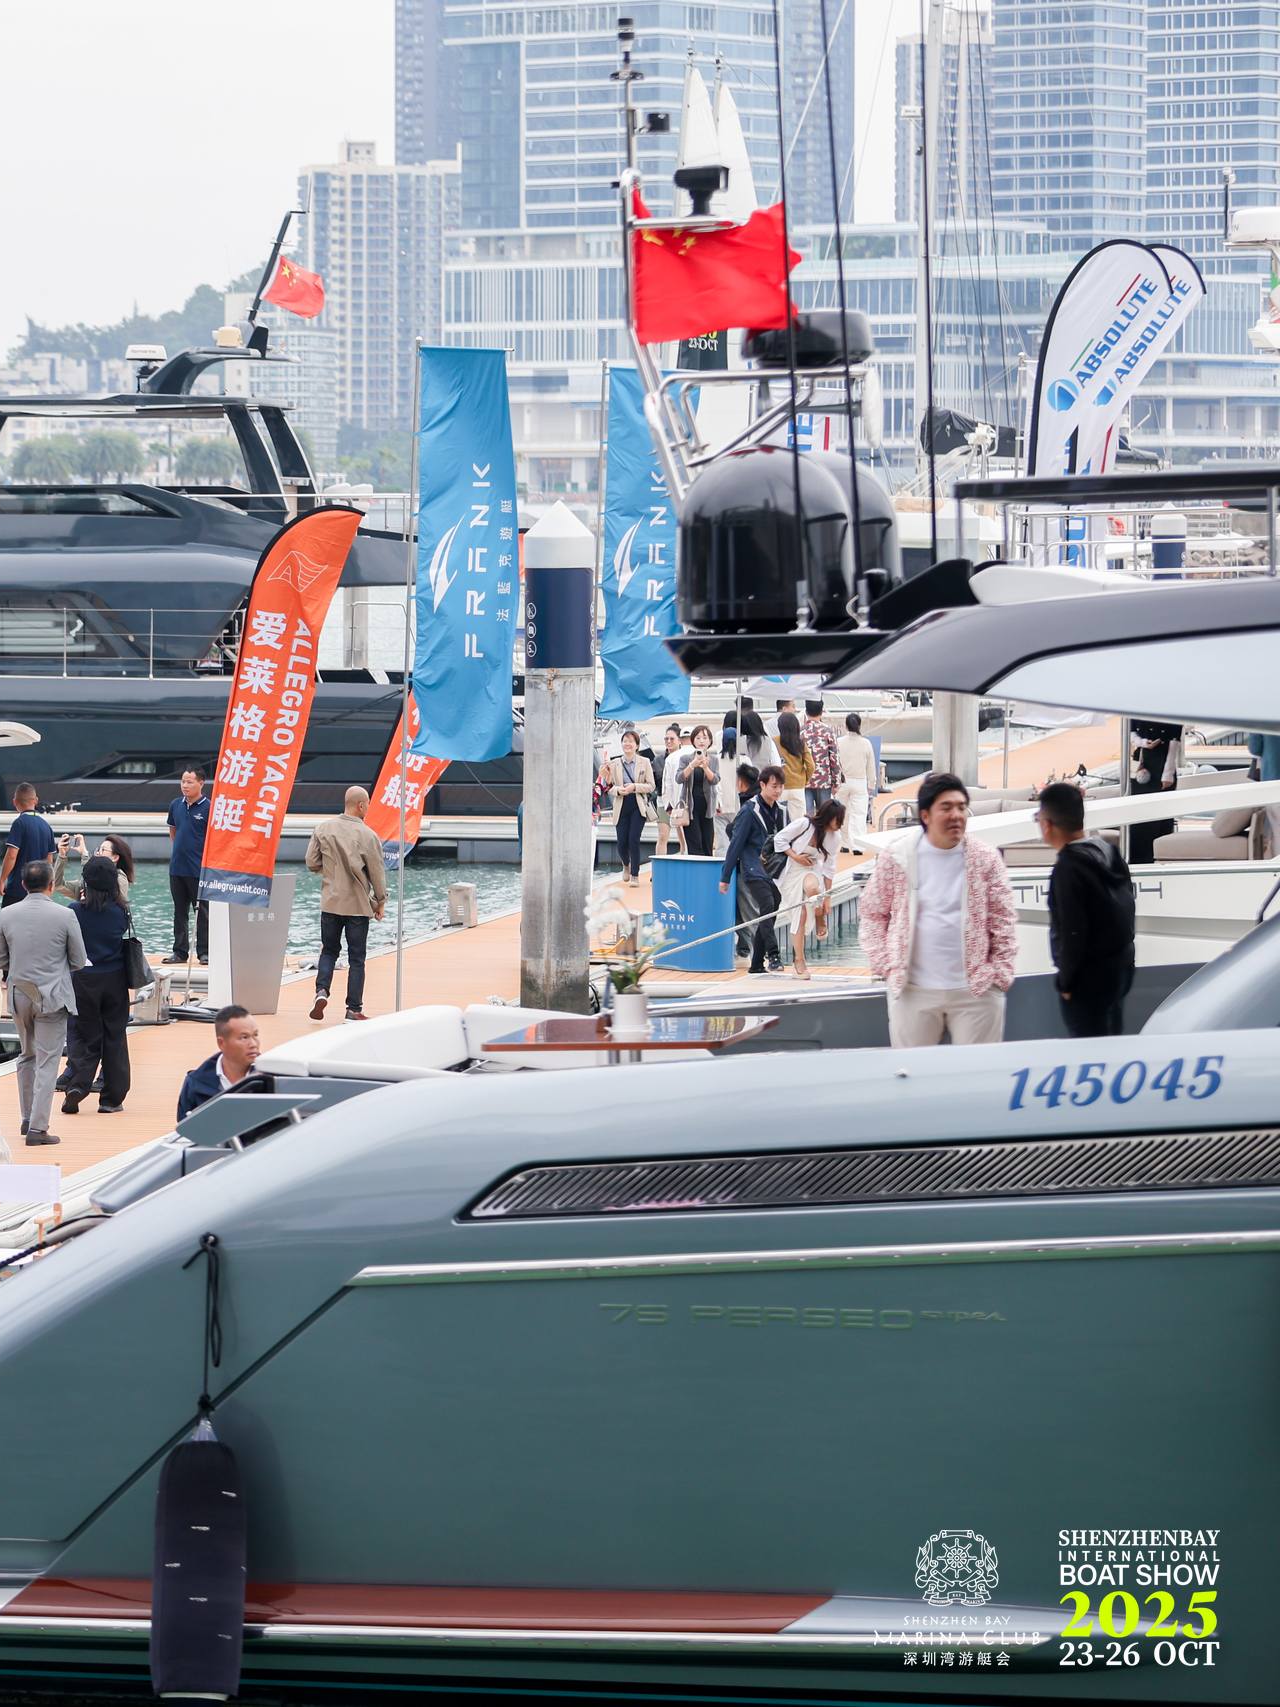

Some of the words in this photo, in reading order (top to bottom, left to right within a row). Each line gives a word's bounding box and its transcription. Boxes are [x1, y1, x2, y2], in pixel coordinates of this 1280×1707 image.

[1076, 278, 1158, 388] ABSOLUTE
[1114, 279, 1192, 385] ABSOLUTE
[464, 463, 491, 658] FRANK
[210, 610, 287, 833] 爱莱格游艇
[272, 618, 313, 746] ALLEGRO
[251, 752, 291, 839] YACHT
[1007, 1055, 1224, 1111] 145045
[690, 1304, 912, 1329] PERSEO
